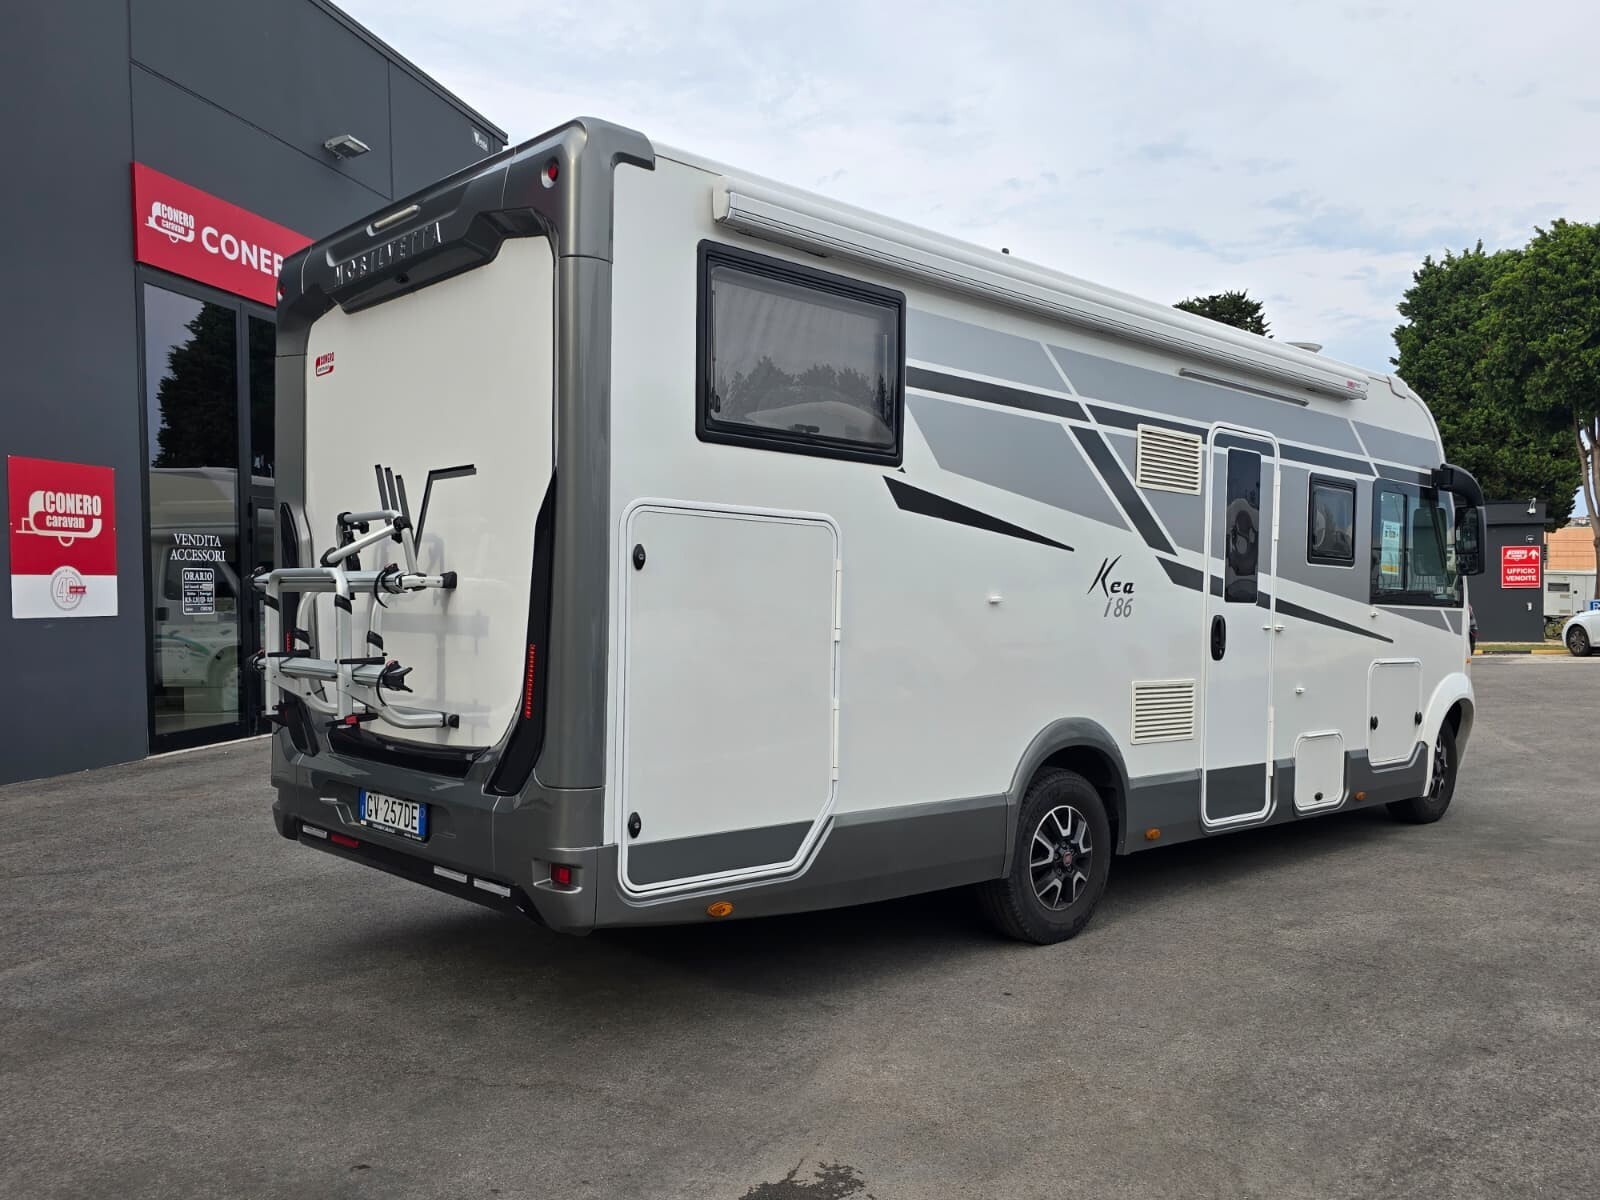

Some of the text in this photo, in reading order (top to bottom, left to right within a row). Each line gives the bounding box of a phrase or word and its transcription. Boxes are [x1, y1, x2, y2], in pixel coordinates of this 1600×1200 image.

[162, 203, 195, 230] CONERO
[161, 219, 185, 235] caravan
[45, 491, 102, 517] CONERO
[45, 515, 85, 529] caravan
[174, 533, 222, 547] VENDITA
[170, 549, 226, 562] ACCESSORI
[184, 571, 213, 581] ORARIO
[1087, 554, 1135, 598] Kea
[366, 794, 380, 820] GV
[383, 799, 418, 832] 257DE
